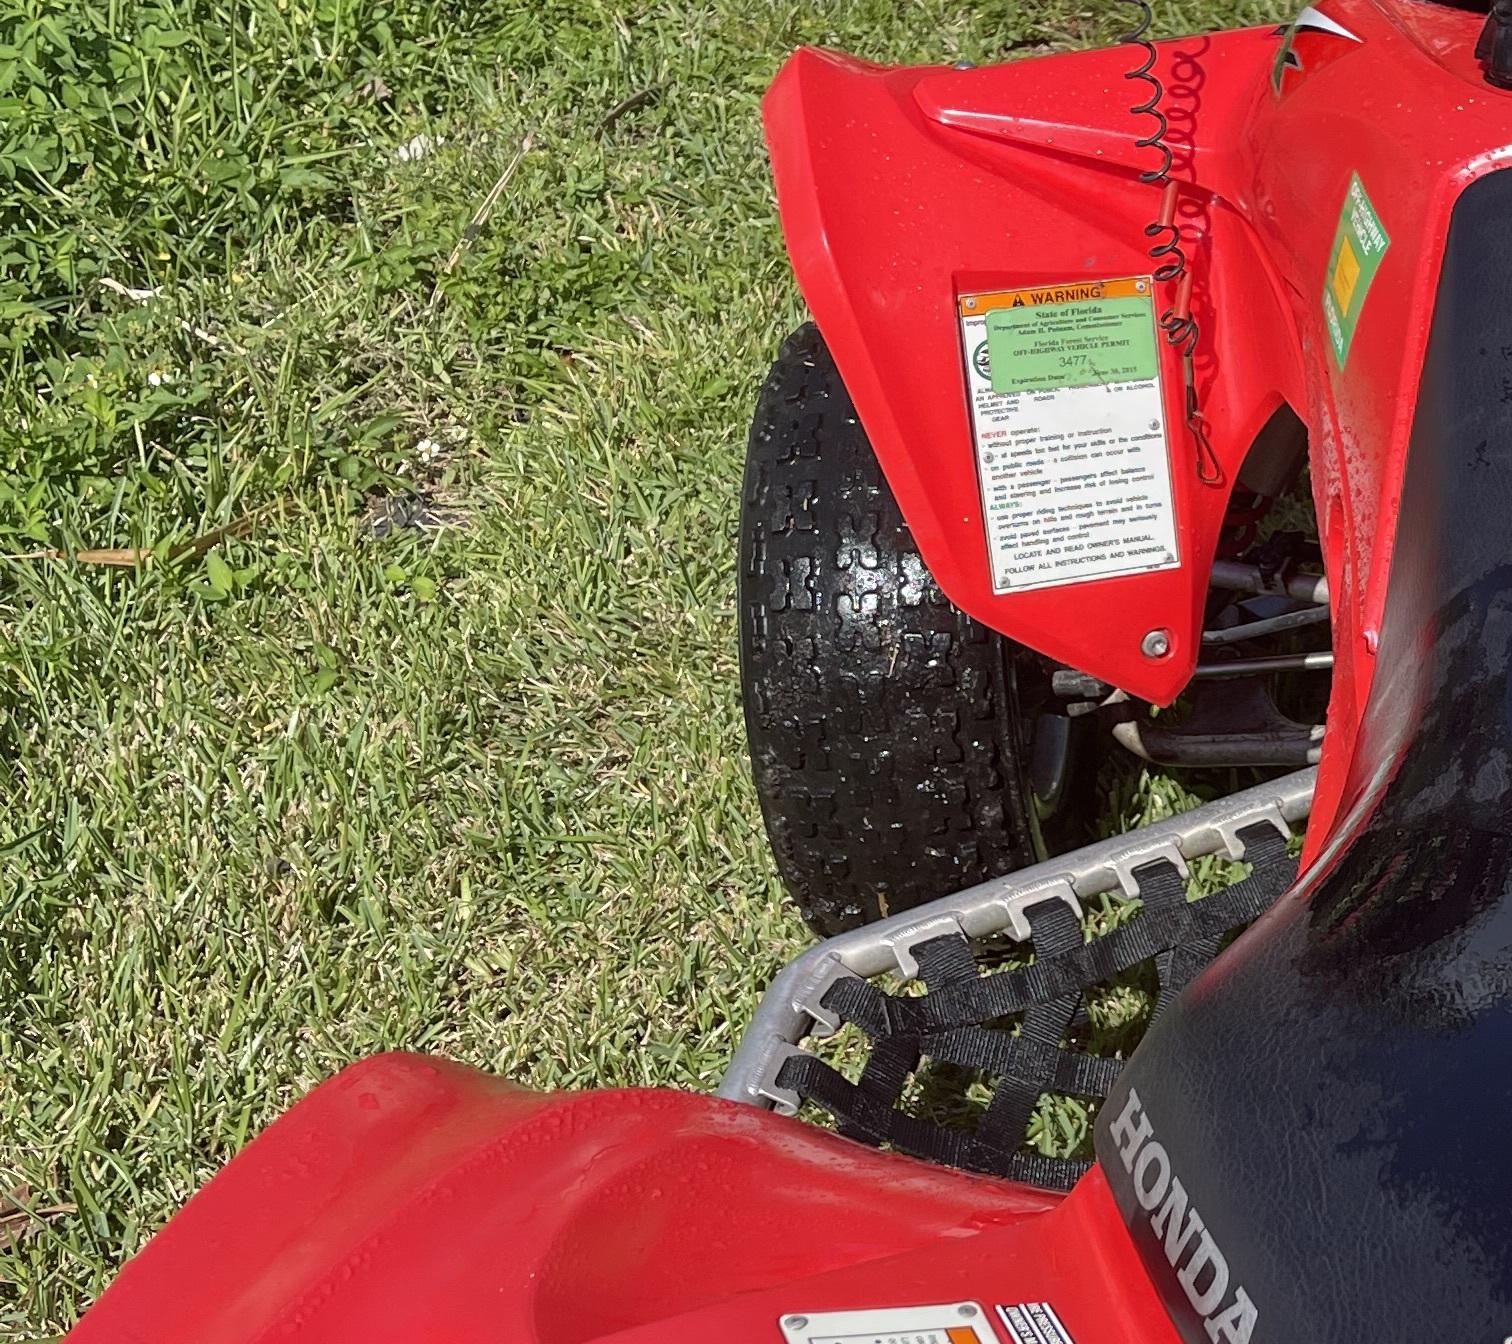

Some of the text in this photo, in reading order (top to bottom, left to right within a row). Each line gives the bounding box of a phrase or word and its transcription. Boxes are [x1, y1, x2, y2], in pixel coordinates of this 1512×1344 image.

[1030, 286, 1100, 305] WARNING
[1034, 305, 1102, 319] State of Florida
[1058, 354, 1087, 367] 3477
